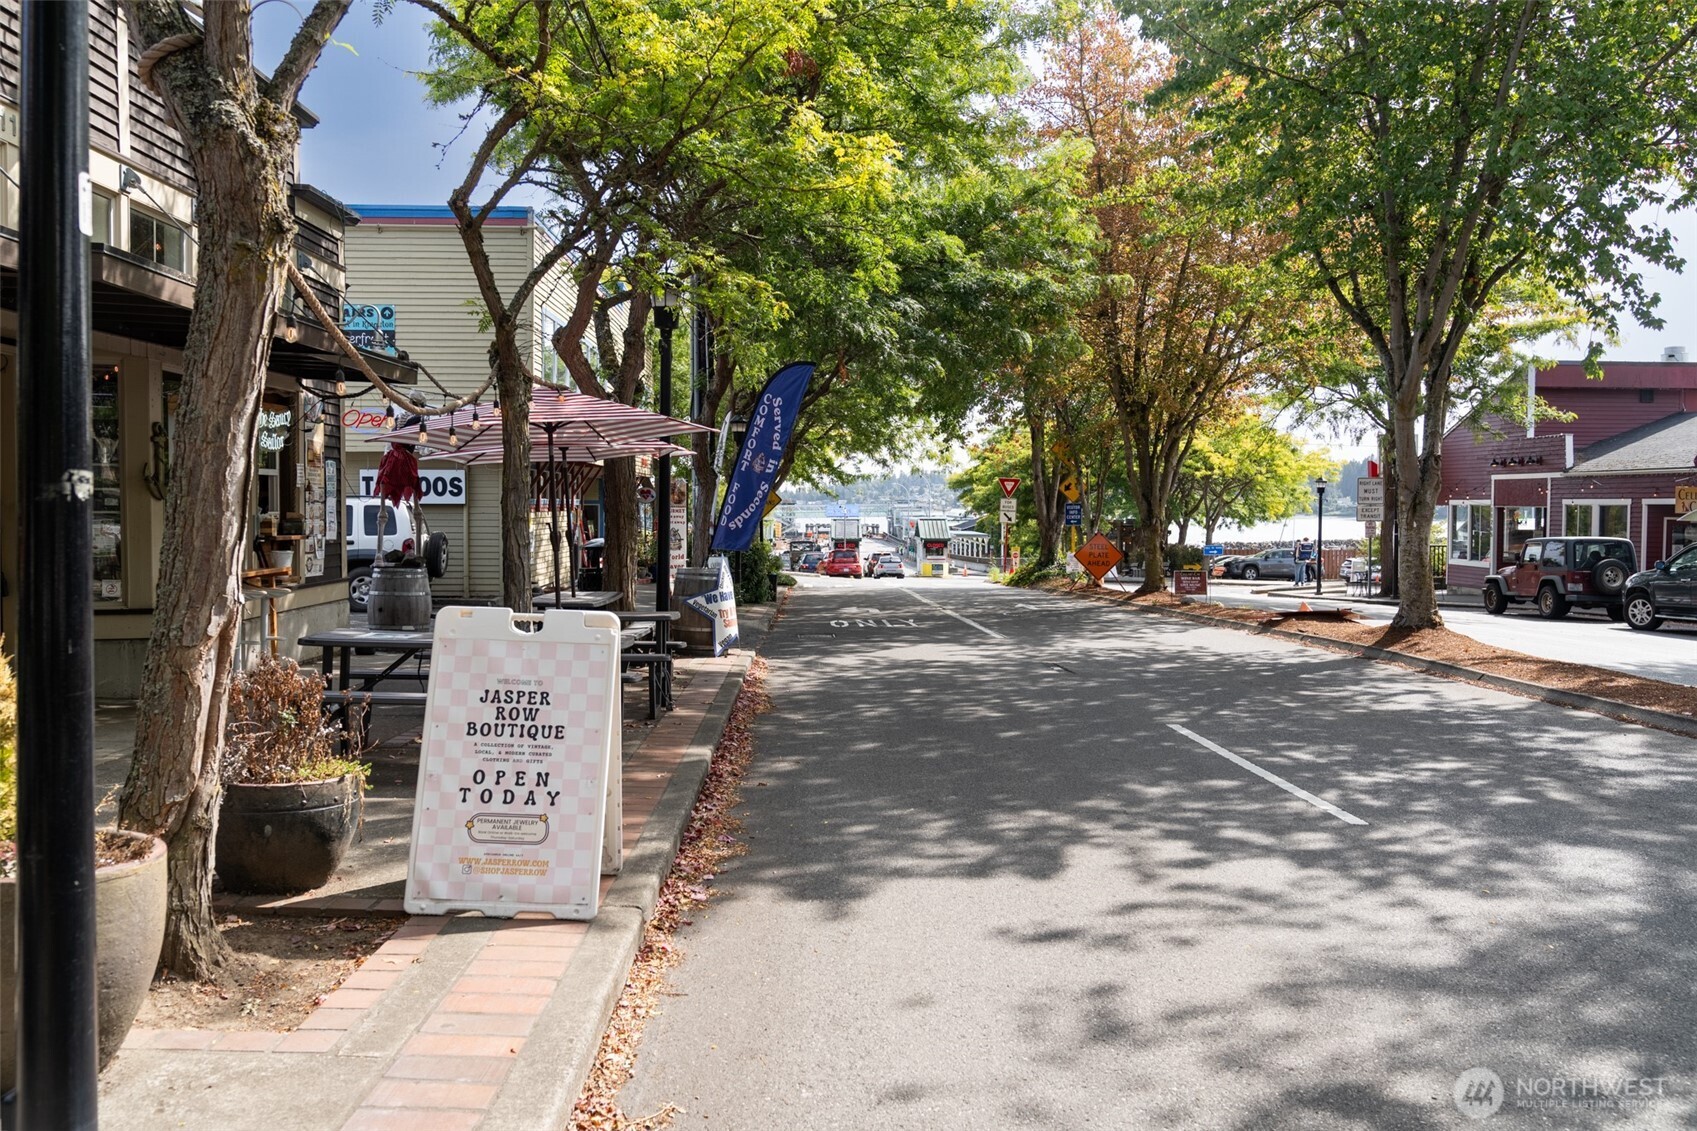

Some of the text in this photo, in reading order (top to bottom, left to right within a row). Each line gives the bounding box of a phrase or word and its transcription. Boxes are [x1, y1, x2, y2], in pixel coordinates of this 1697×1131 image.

[343, 308, 374, 317] AIRS
[349, 332, 389, 346] erfrt
[259, 408, 268, 428] he
[740, 393, 773, 472] COMFORT
[728, 396, 783, 531] Served in Seconds
[362, 476, 464, 498] TOOS
[720, 482, 741, 526] FOOD
[1088, 551, 1109, 559] PLATE
[1087, 559, 1111, 567] AHEAD
[704, 593, 718, 605] We
[692, 599, 718, 619] Vegetarian
[829, 618, 919, 628] ONLY
[717, 633, 732, 648] Vegan
[496, 678, 544, 687] WELCOME TO
[479, 688, 552, 706] JASPER
[494, 705, 541, 722] ROW
[465, 721, 566, 741] BOUTIQUE
[472, 768, 551, 788] OPEN
[458, 786, 562, 807] TODAY
[477, 817, 512, 825] PERMANENT
[492, 823, 523, 831] AVAILABLE
[458, 857, 550, 868] WWW.JASPERROW.COM
[473, 866, 549, 876] @SHOPJASPERROW
